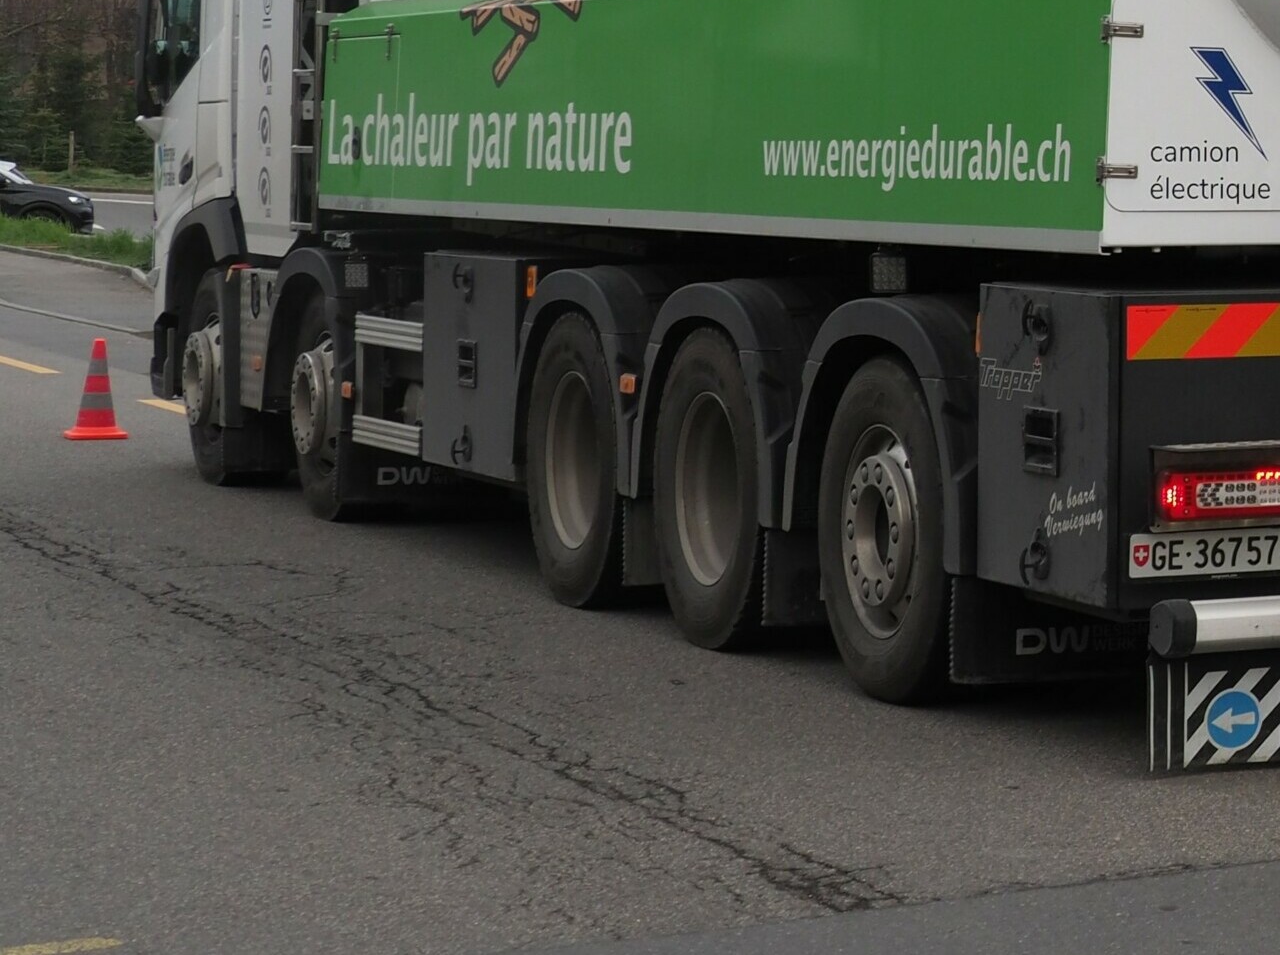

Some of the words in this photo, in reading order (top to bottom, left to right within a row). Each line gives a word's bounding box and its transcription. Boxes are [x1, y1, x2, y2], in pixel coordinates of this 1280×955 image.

[327, 98, 354, 165] La
[361, 92, 459, 168] chaleur
[466, 111, 517, 187] par
[526, 101, 632, 174] nature
[1149, 140, 1240, 164] camion
[763, 122, 1071, 192] www.energiedurable.ch
[1149, 175, 1271, 205] électrique
[979, 357, 1042, 401] Tropper
[376, 466, 431, 486] DW
[1049, 491, 1063, 514] On
[1066, 480, 1096, 508] board
[1044, 507, 1104, 538] Verwiegung
[1015, 626, 1090, 656] DW
